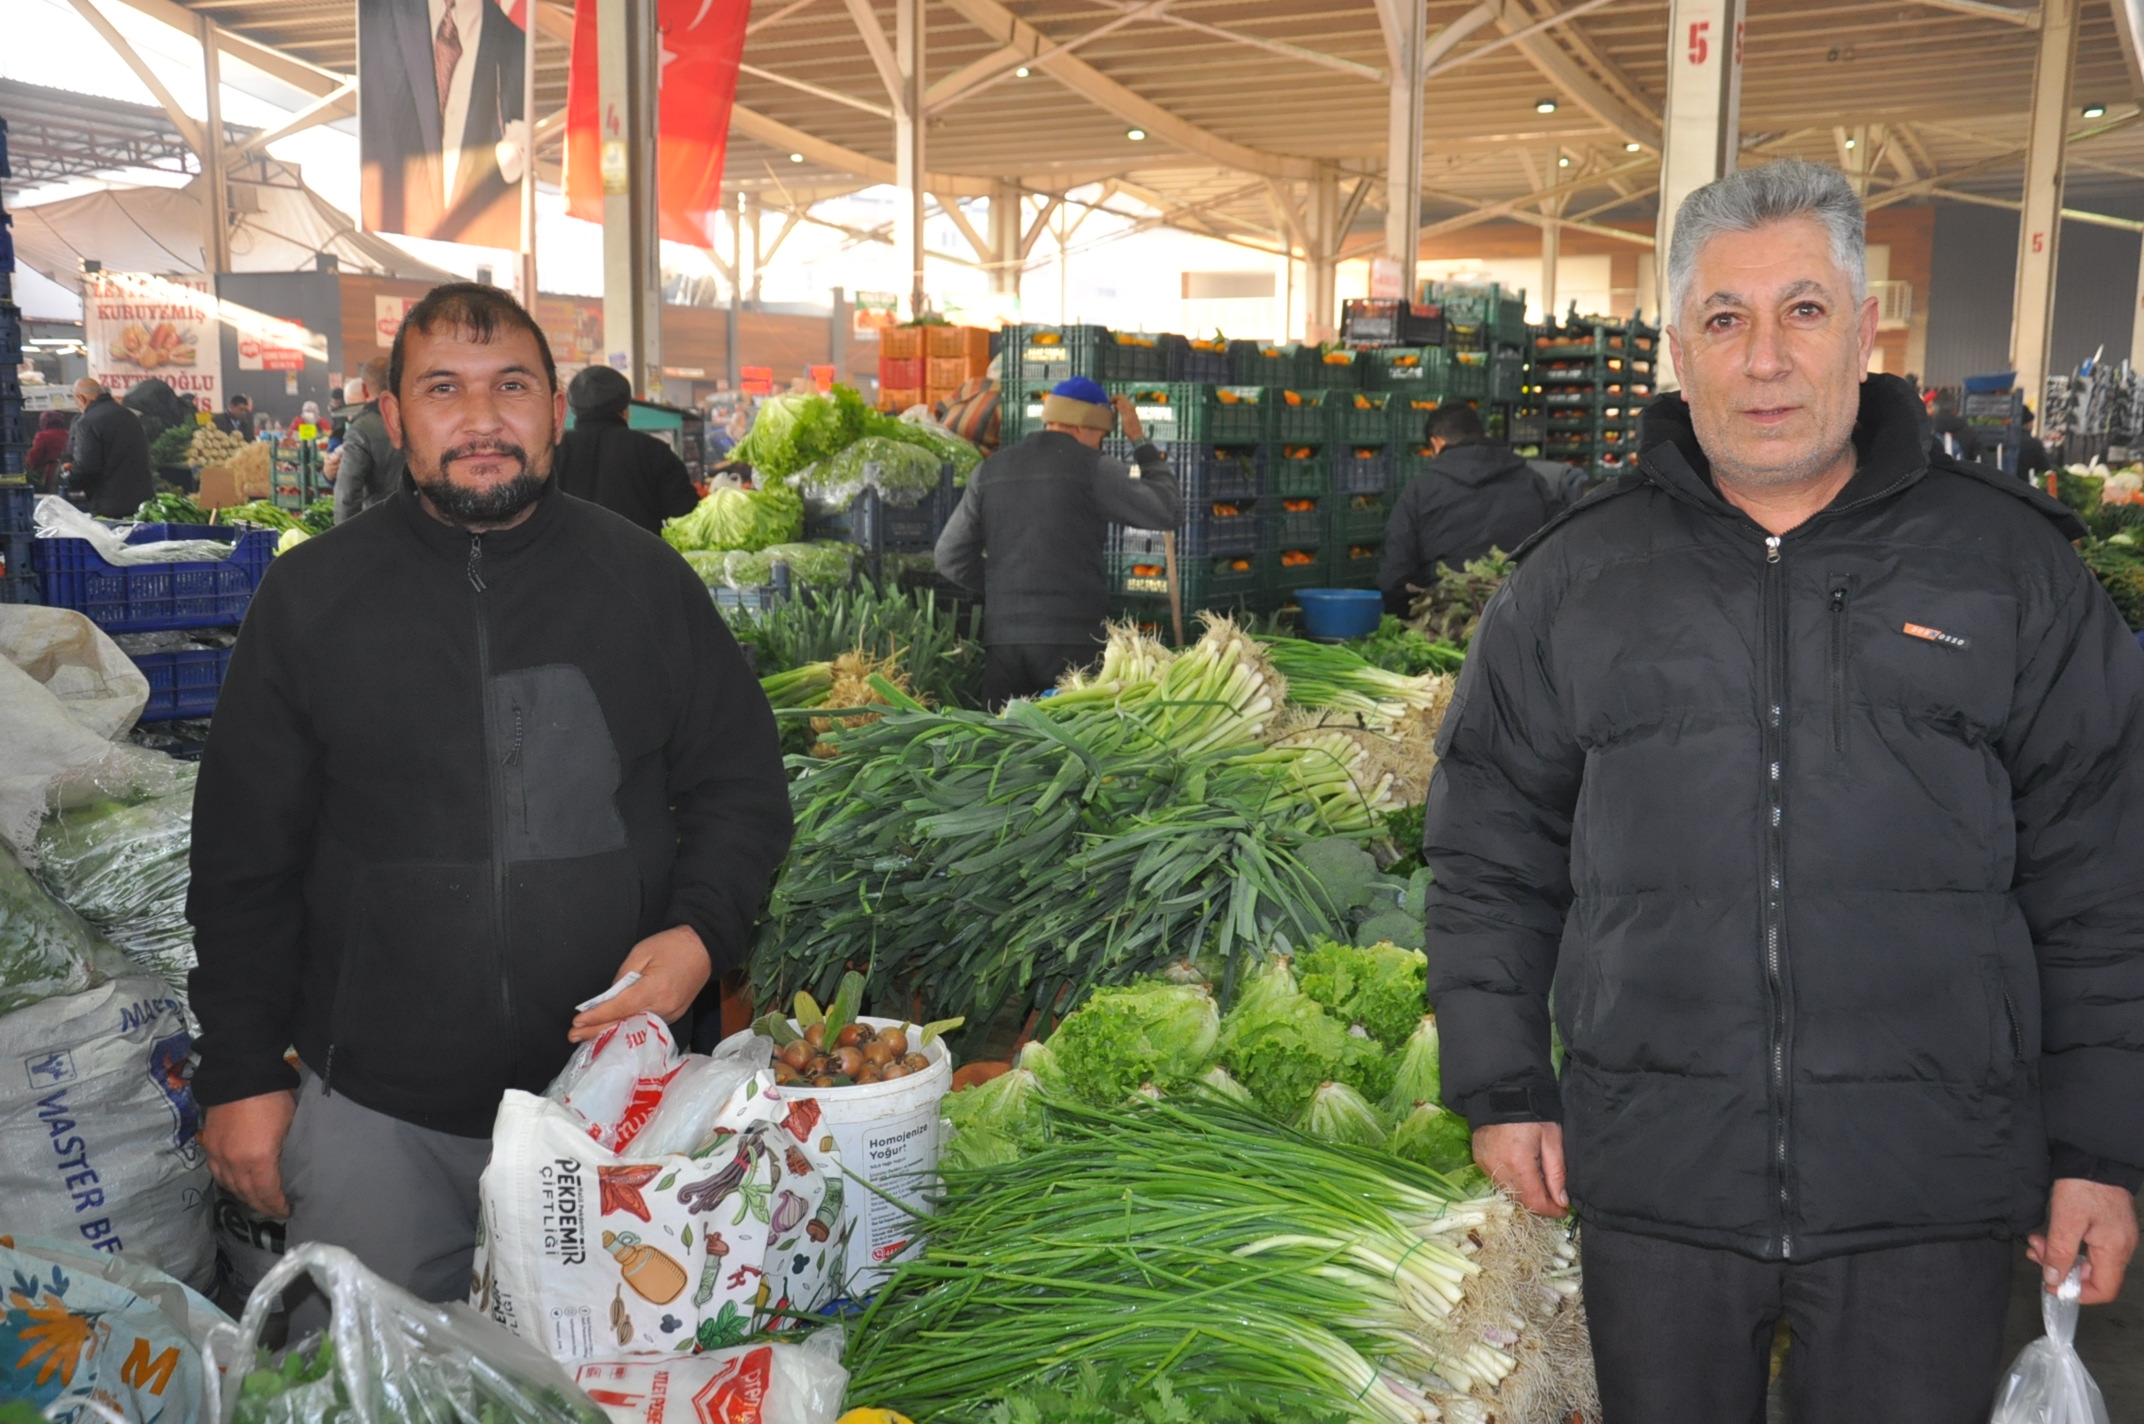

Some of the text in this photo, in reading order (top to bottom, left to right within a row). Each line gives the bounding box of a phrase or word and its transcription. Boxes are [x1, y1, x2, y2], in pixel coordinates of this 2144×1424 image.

[1688, 22, 1709, 65] 5
[606, 103, 620, 136] 4
[2032, 232, 2044, 253] 5
[97, 304, 206, 324] KURUYEMİŞ
[99, 371, 215, 390] ZEYOĞLU
[869, 1123, 928, 1149] Homojenize
[37, 1089, 104, 1212] MASTER
[869, 1144, 907, 1160] Yoğurt
[539, 1166, 559, 1255] ÇİFTLİĞİ
[555, 1157, 586, 1265] PEKDEMİR
[652, 1371, 670, 1395] ATLET
